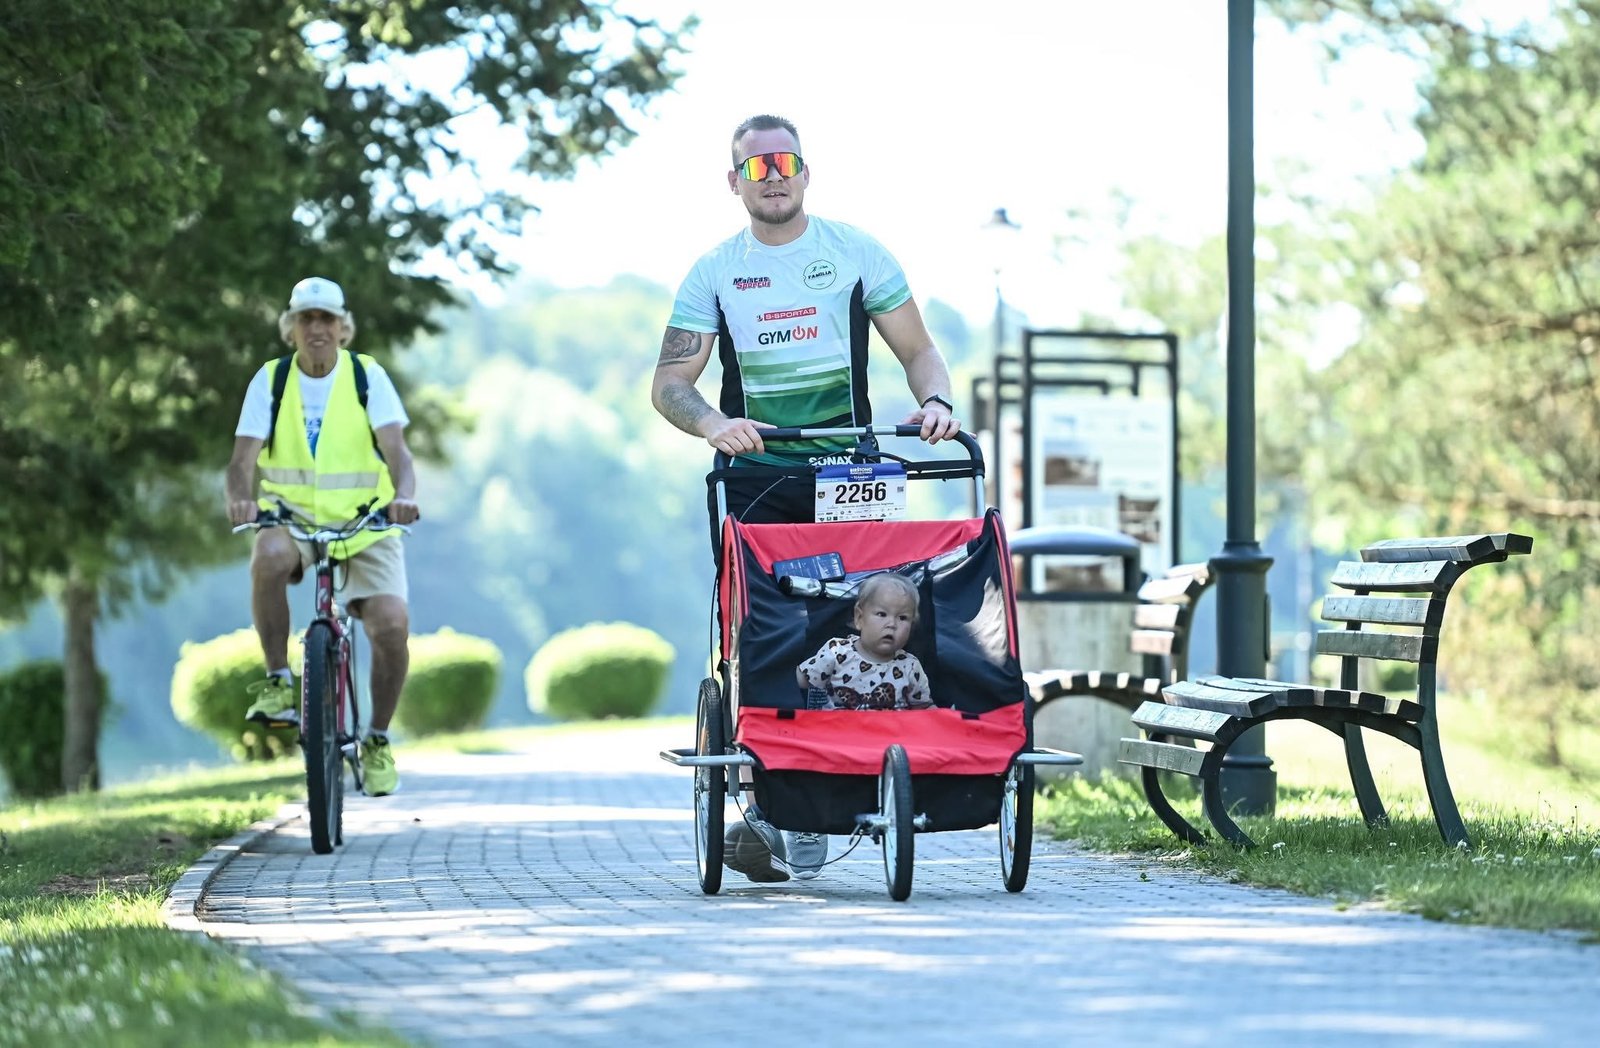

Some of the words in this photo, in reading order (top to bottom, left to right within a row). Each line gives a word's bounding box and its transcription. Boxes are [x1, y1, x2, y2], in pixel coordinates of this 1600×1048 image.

[808, 270, 832, 279] FAMILIA
[765, 308, 815, 319] S-SPORTAS
[758, 326, 818, 345] GYMON
[809, 455, 853, 466] SONAX
[835, 482, 887, 504] 2256
